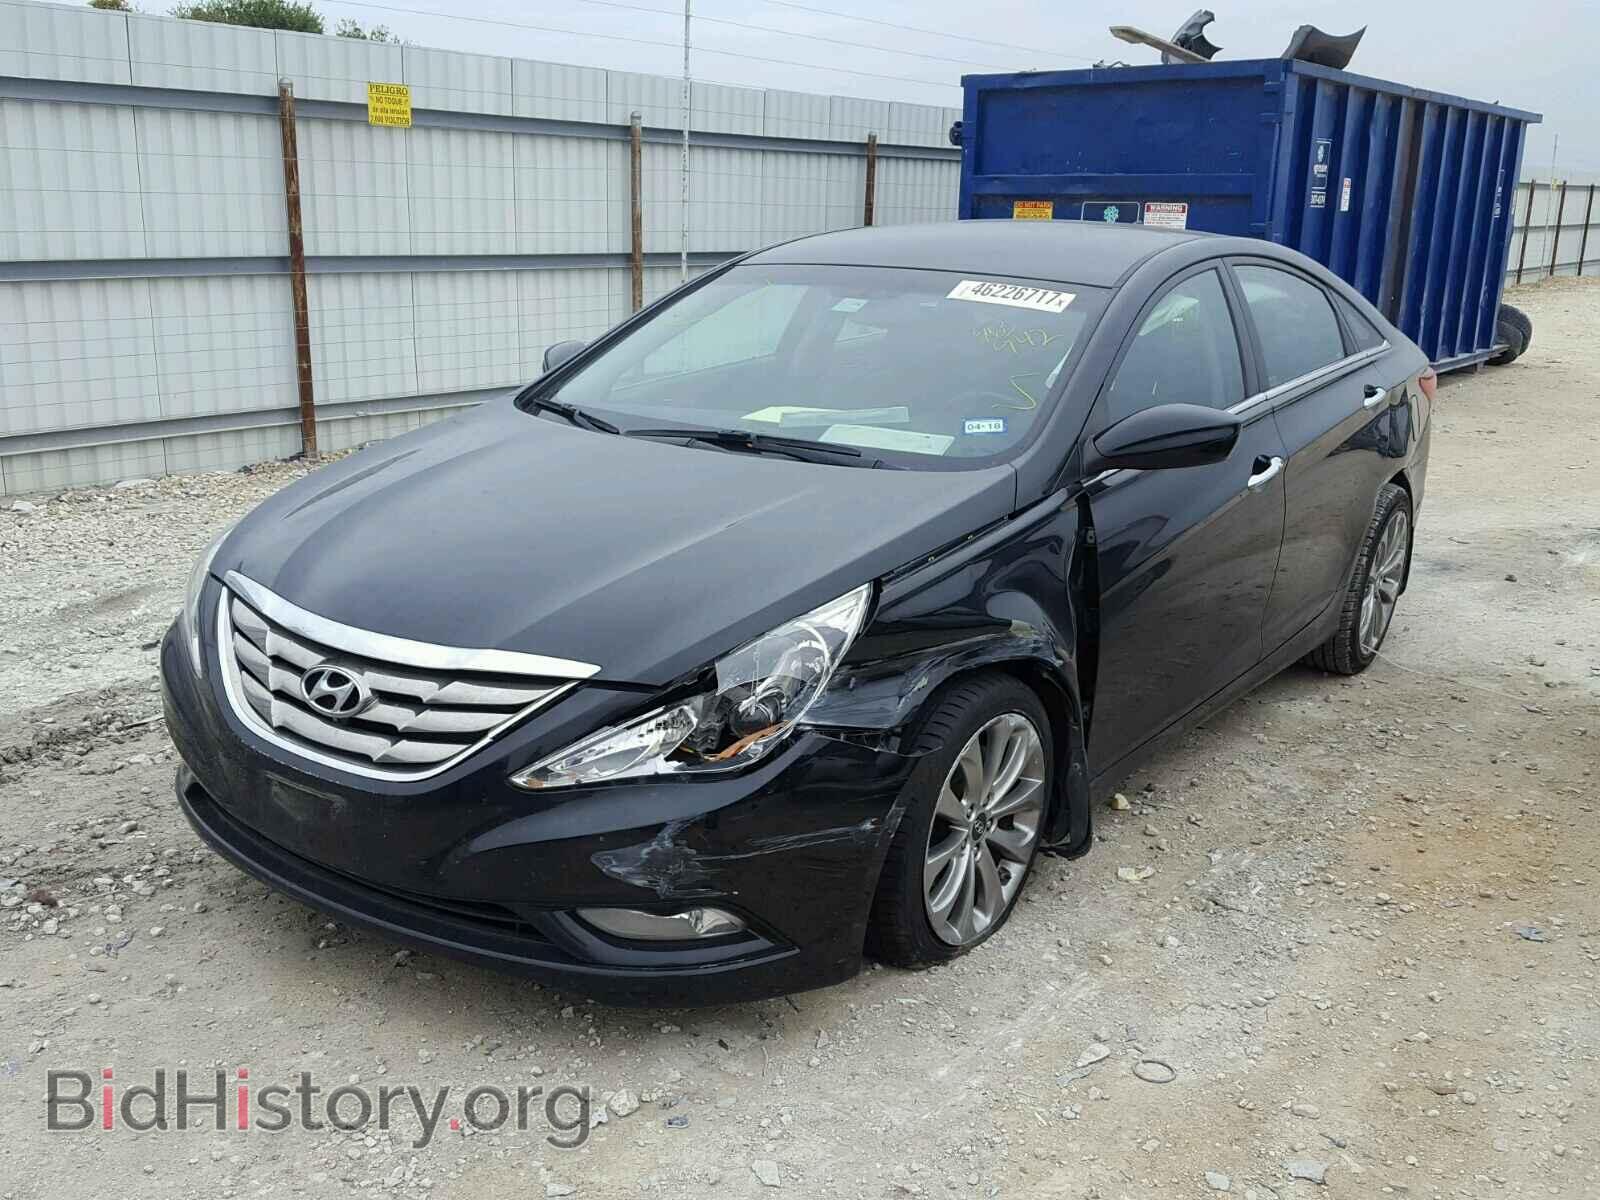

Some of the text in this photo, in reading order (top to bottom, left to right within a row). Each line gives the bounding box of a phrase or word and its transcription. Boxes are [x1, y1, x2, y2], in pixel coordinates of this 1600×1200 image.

[369, 84, 408, 96] PELIGRO
[376, 96, 403, 105] NO TOQUE
[1151, 203, 1183, 213] WARNING
[971, 282, 1062, 305] 46226717
